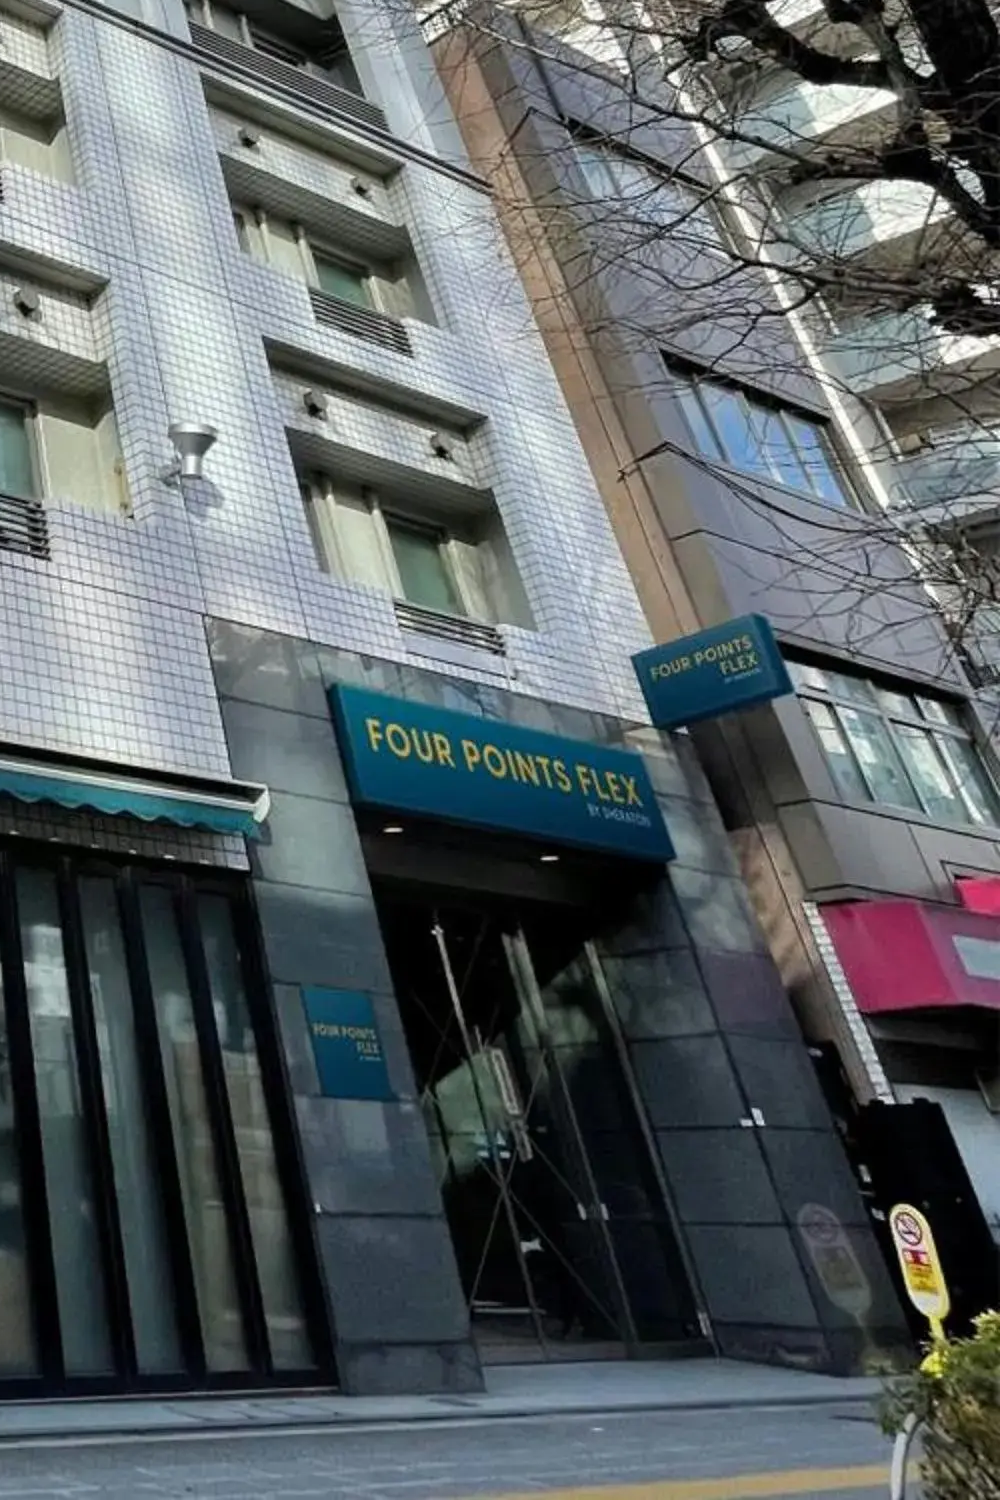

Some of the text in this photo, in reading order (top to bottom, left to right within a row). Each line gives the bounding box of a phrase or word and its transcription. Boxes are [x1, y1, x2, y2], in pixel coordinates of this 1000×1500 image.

[650, 635, 752, 680] FOUR POINTS
[720, 651, 758, 675] FLEX
[365, 717, 644, 807] FOUR POINTS FLEX
